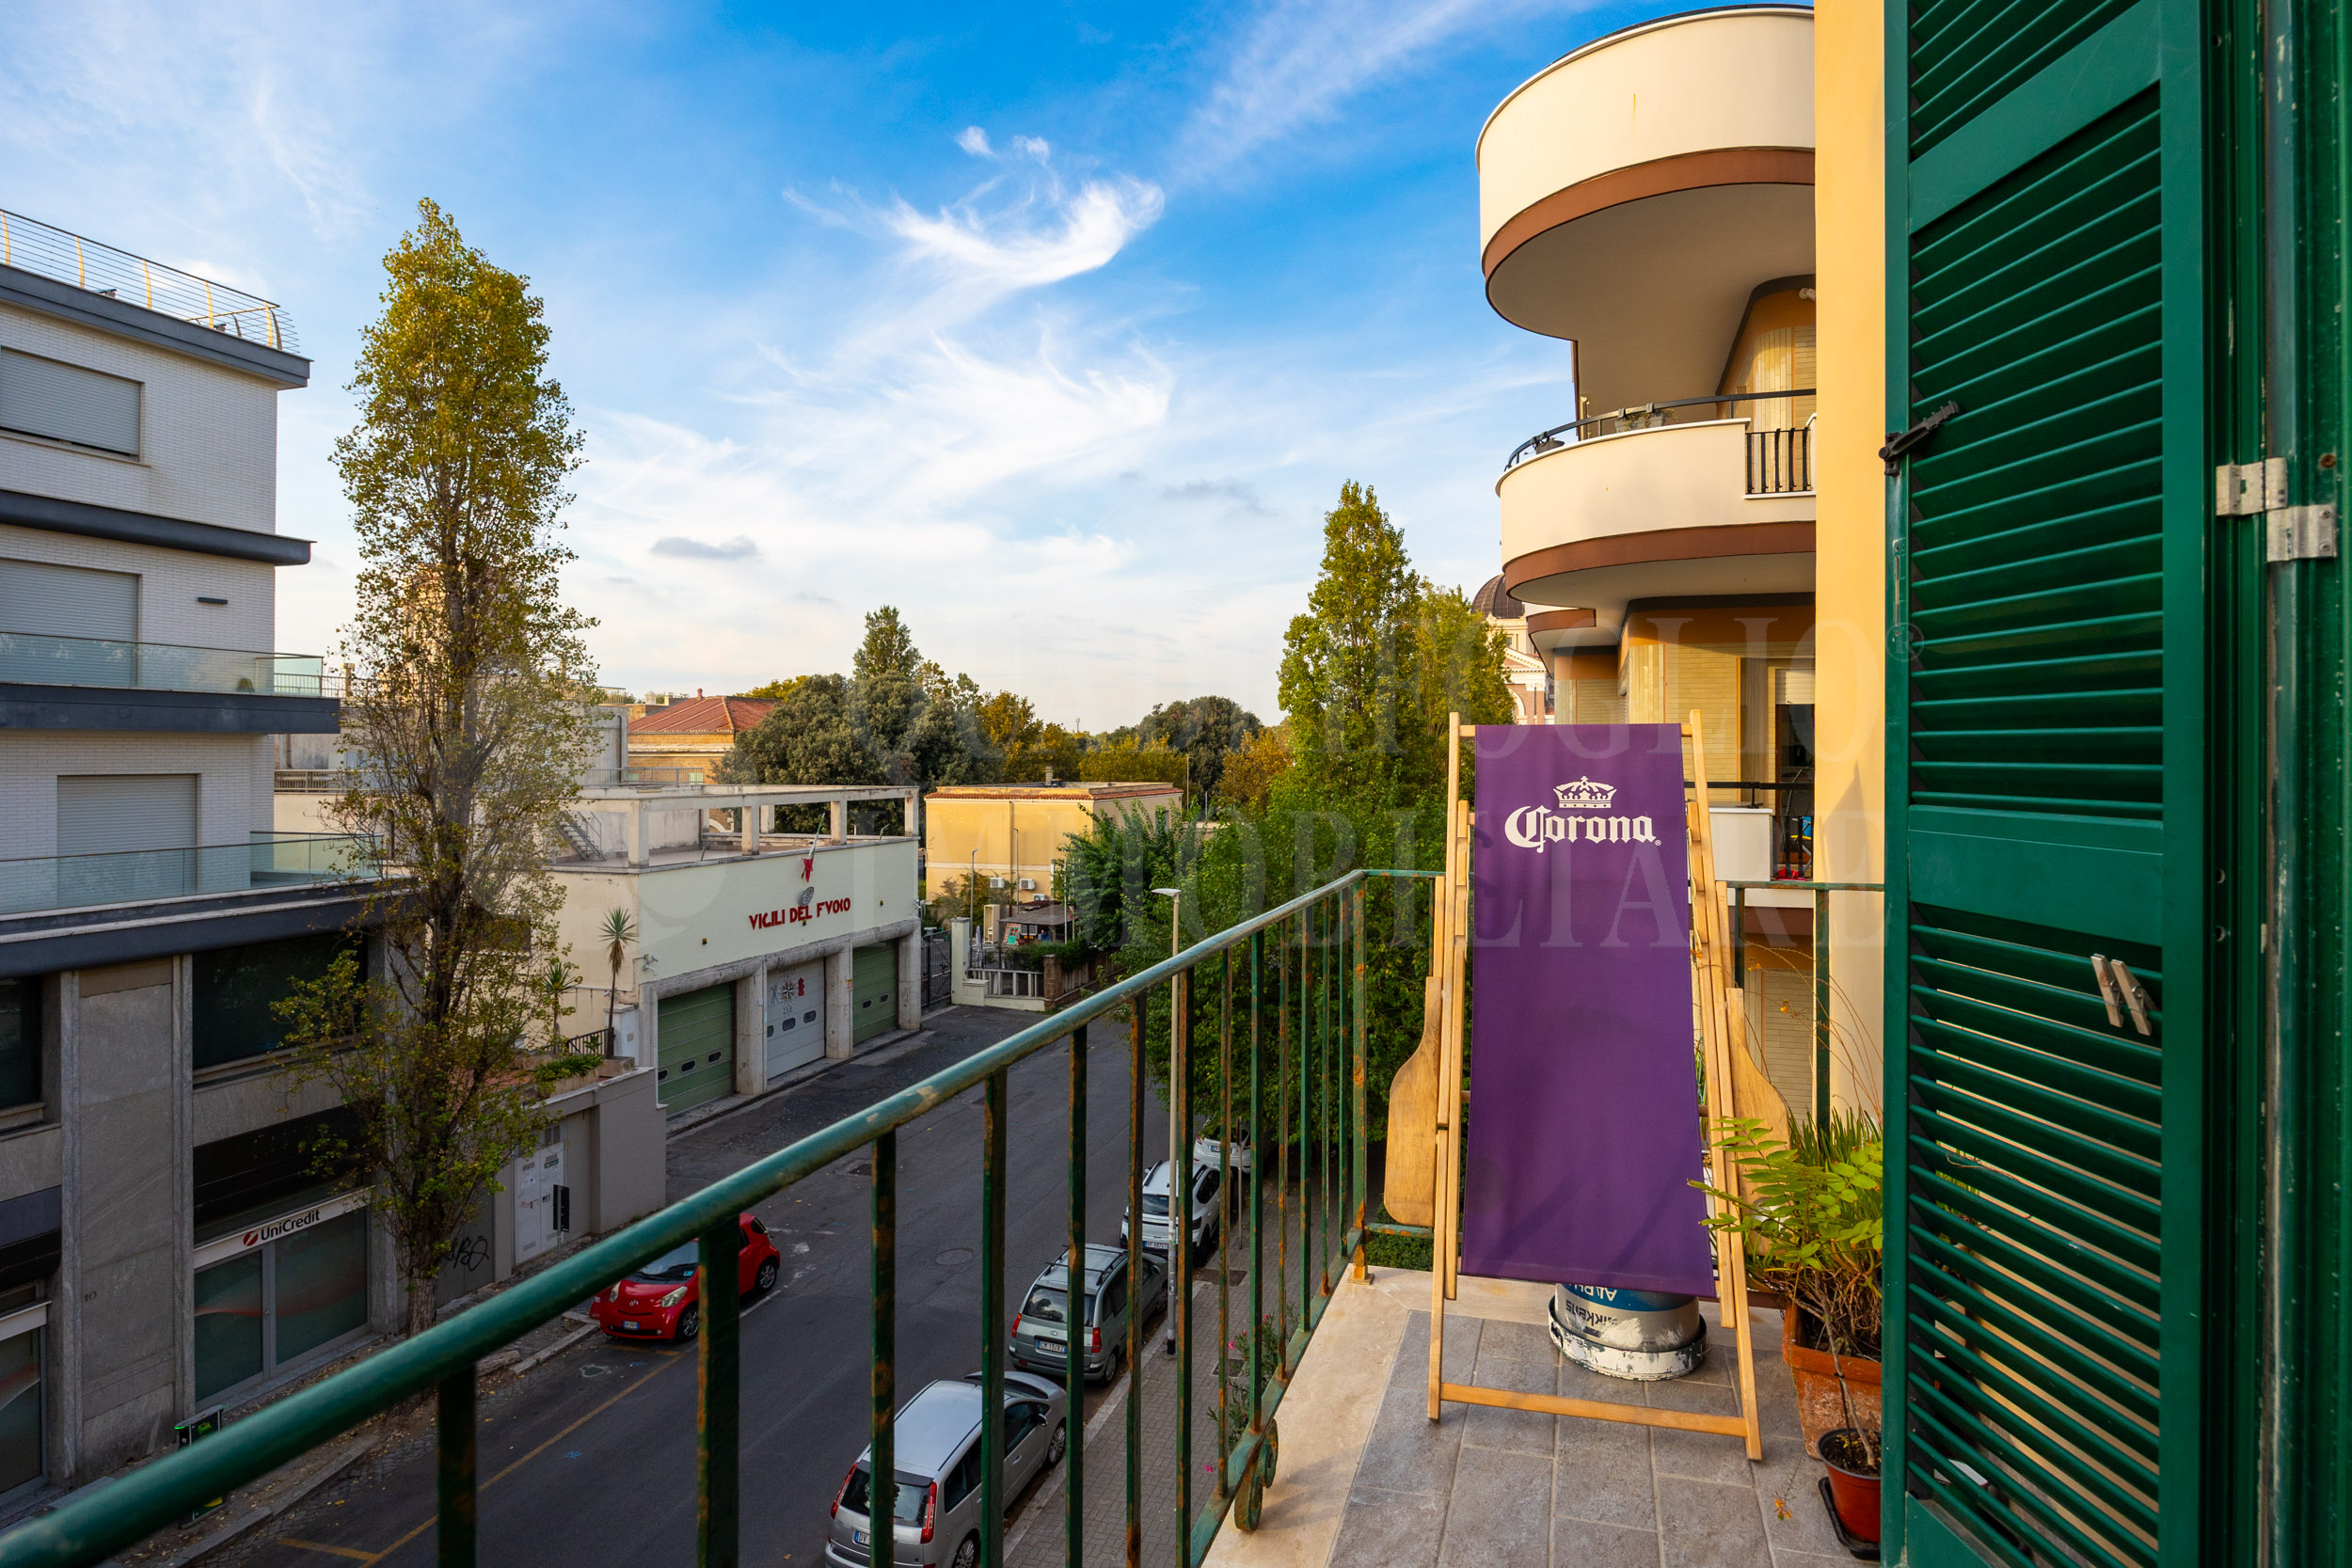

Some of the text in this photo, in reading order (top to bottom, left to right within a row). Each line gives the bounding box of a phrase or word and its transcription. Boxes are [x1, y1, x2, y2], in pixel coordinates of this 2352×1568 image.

[1504, 804, 1657, 853] Corona
[789, 904, 812, 924] DEL
[261, 1209, 320, 1241] UniCredit
[85, 1291, 97, 1302] 10
